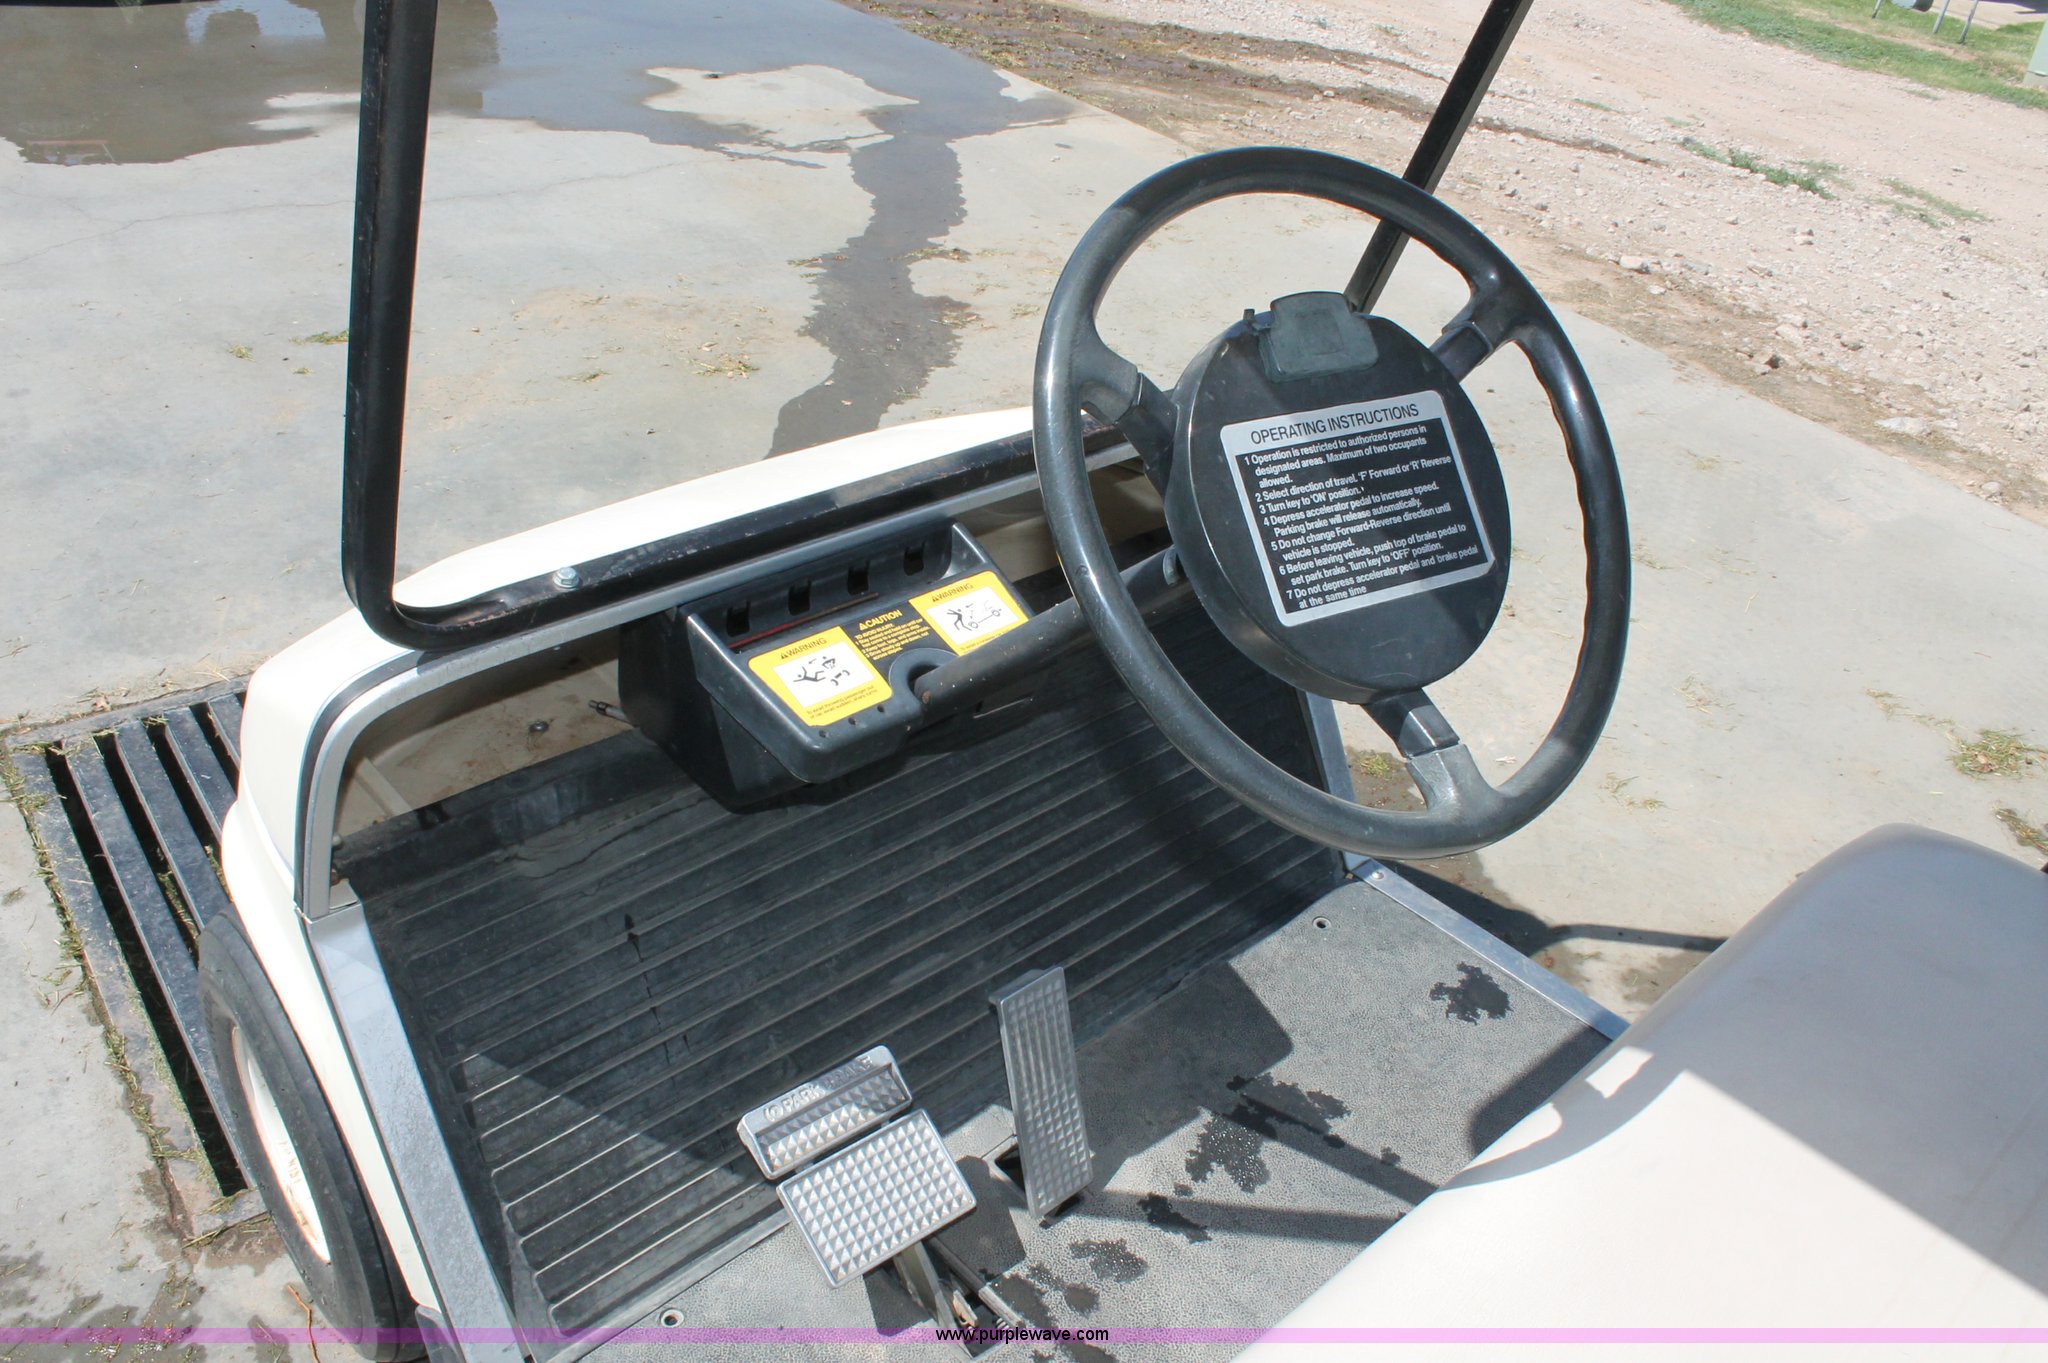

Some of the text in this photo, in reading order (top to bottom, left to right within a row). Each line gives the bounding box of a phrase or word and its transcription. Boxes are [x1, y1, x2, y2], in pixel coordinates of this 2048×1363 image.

[1251, 404, 1419, 444] OPERATING INSTRUCTIONS
[1245, 456, 1249, 465] 1
[1251, 450, 1292, 466] Operation
[1292, 448, 1300, 456] is
[1301, 441, 1337, 456] restricted
[1348, 431, 1387, 447] authorized
[1388, 428, 1418, 441] persons
[1256, 437, 1426, 476] designated areas. Maximum of two occupants
[1255, 493, 1262, 502] 2
[1262, 490, 1289, 500] Select
[1290, 482, 1324, 496] direction
[1325, 478, 1333, 488] of
[1369, 465, 1401, 479] Forward
[1421, 456, 1451, 468] Reverse
[1259, 474, 1292, 488] allowed.
[1259, 505, 1266, 514] 3
[1266, 502, 1286, 513] Turn
[1286, 498, 1300, 508] key
[1301, 496, 1310, 505] to
[1328, 486, 1361, 502] position.
[1264, 481, 1439, 526] 4 Depress accelerator pedal to increase speed.
[1274, 497, 1422, 537] Parking brake will release automatically.
[1271, 502, 1451, 550] 5 Do not change Forward-Reverse direction until
[1279, 524, 1466, 575] 6 Before leaving vehicle, push top of brake pedal to
[1283, 537, 1355, 561] vehicle is stopped.
[1291, 576, 1305, 586] set
[1305, 570, 1323, 584] park
[1323, 565, 1348, 578] brake.
[1348, 561, 1367, 571] Turn
[1367, 557, 1381, 566] key
[1382, 554, 1391, 563] to
[1412, 542, 1443, 557] position.
[1286, 545, 1478, 599] 7 Do not depress accelerator pedal and brake pedal
[939, 583, 974, 600] WARNING
[1299, 586, 1367, 608] at the same time
[866, 609, 902, 627] CAUTION
[787, 638, 827, 657] WARNING
[782, 1083, 826, 1112] PARK
